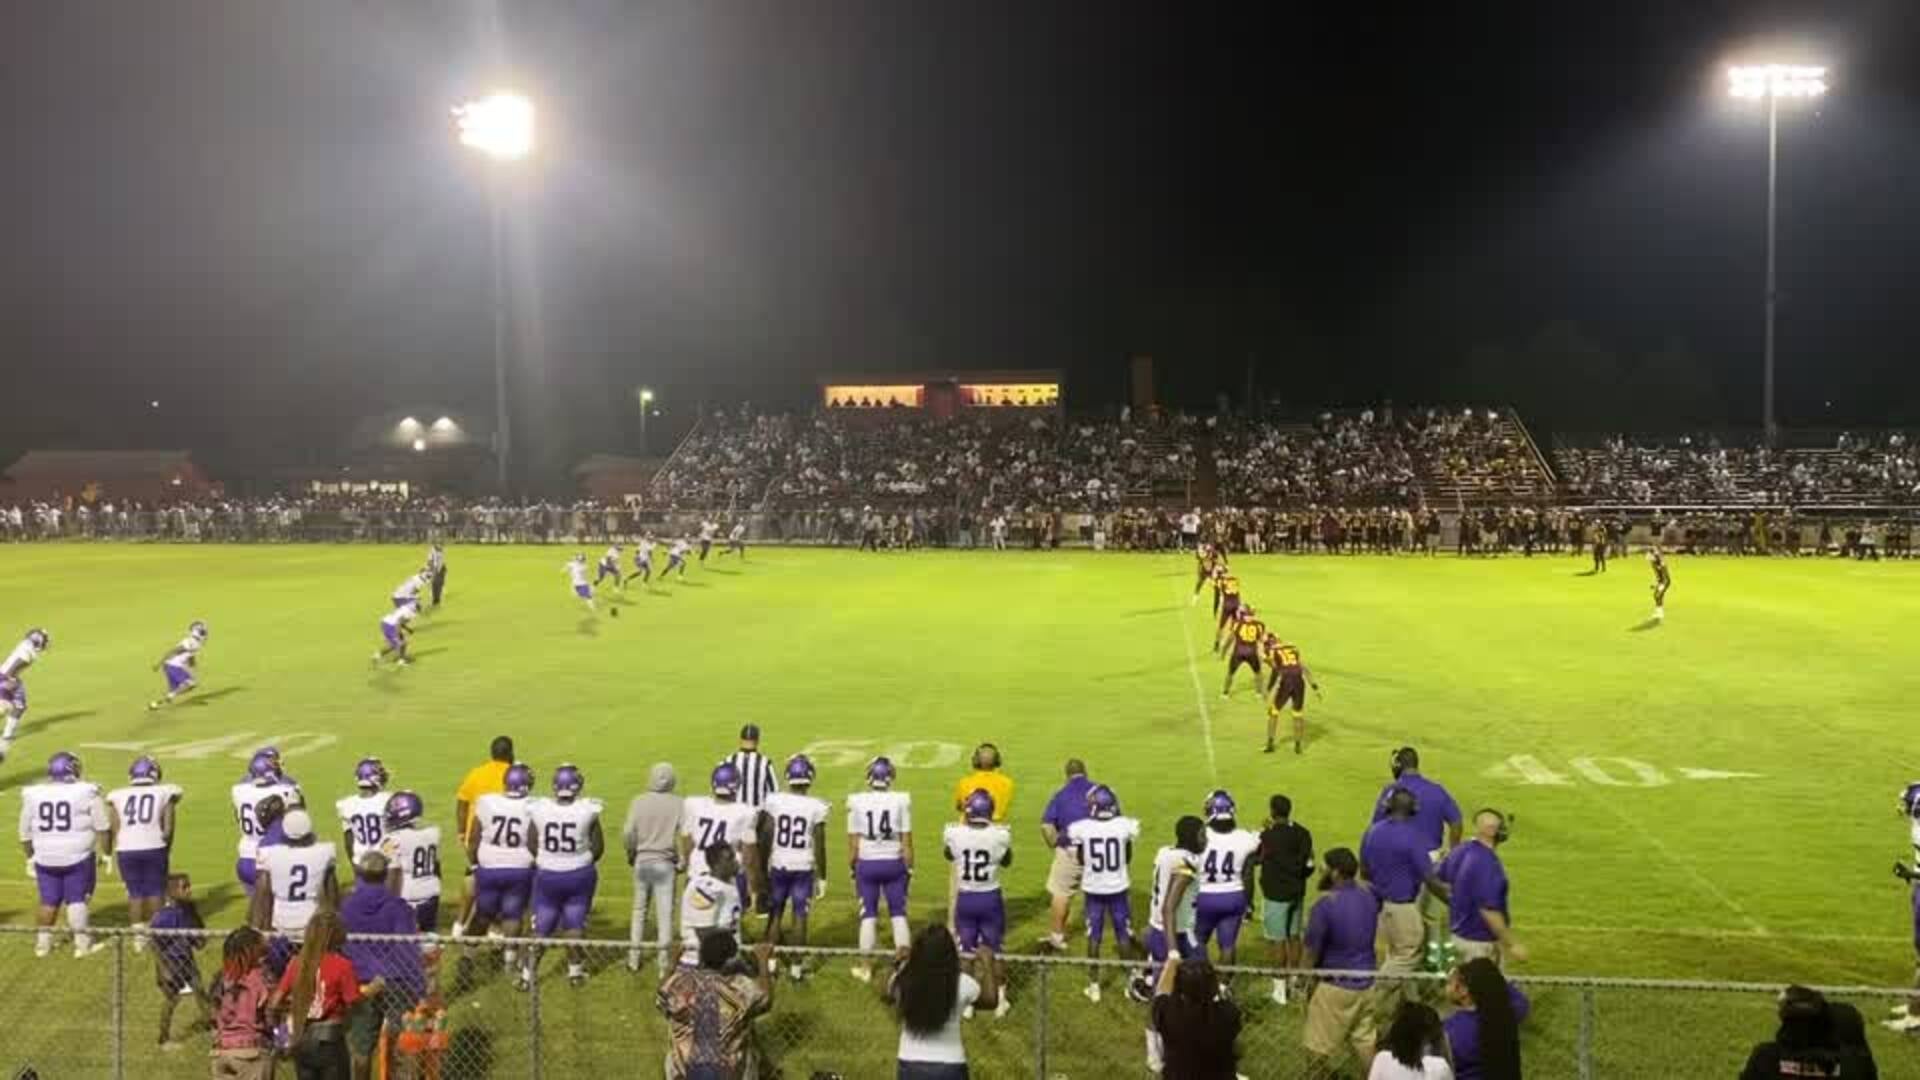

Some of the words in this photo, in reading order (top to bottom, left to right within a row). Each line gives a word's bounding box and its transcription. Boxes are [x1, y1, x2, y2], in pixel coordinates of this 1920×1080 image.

[1480, 754, 1674, 786] 40
[39, 801, 71, 832] 99
[123, 794, 154, 824] 40
[865, 810, 893, 840] 14
[351, 813, 382, 844] 38
[492, 816, 521, 847] 76
[545, 822, 577, 852] 65
[698, 817, 727, 850] 74
[777, 815, 806, 848] 82
[412, 844, 437, 878] 80
[961, 849, 990, 881] 12
[1088, 838, 1121, 871] 50
[1204, 850, 1235, 882] 44
[288, 864, 308, 901] 2
